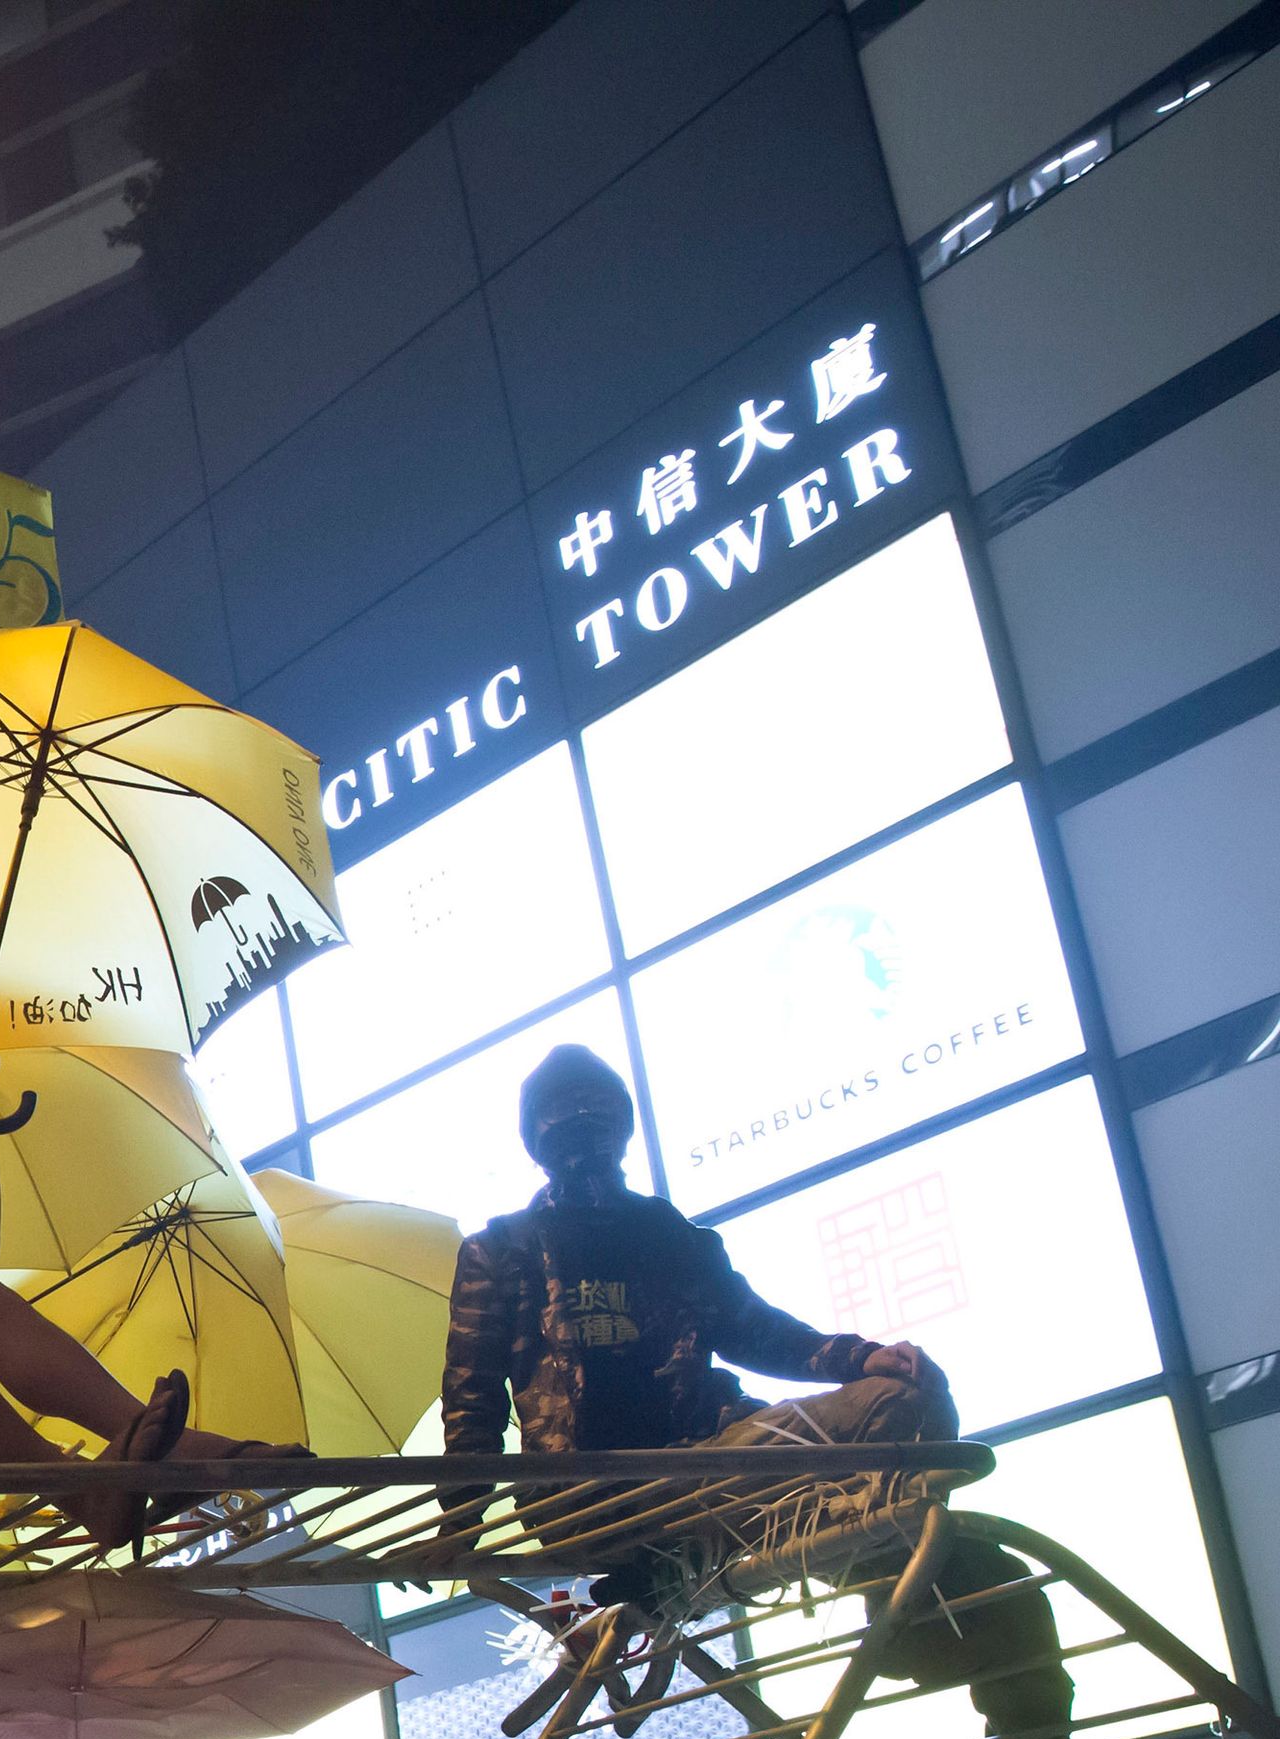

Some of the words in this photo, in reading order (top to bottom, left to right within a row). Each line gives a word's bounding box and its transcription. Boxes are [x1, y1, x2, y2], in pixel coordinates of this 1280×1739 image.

[559, 322, 888, 577] 中信大廈
[321, 665, 527, 830] CITIC
[576, 427, 912, 669] TOWER
[689, 1070, 880, 1169] STARBUCKS
[900, 1001, 1038, 1076] COFFEE
